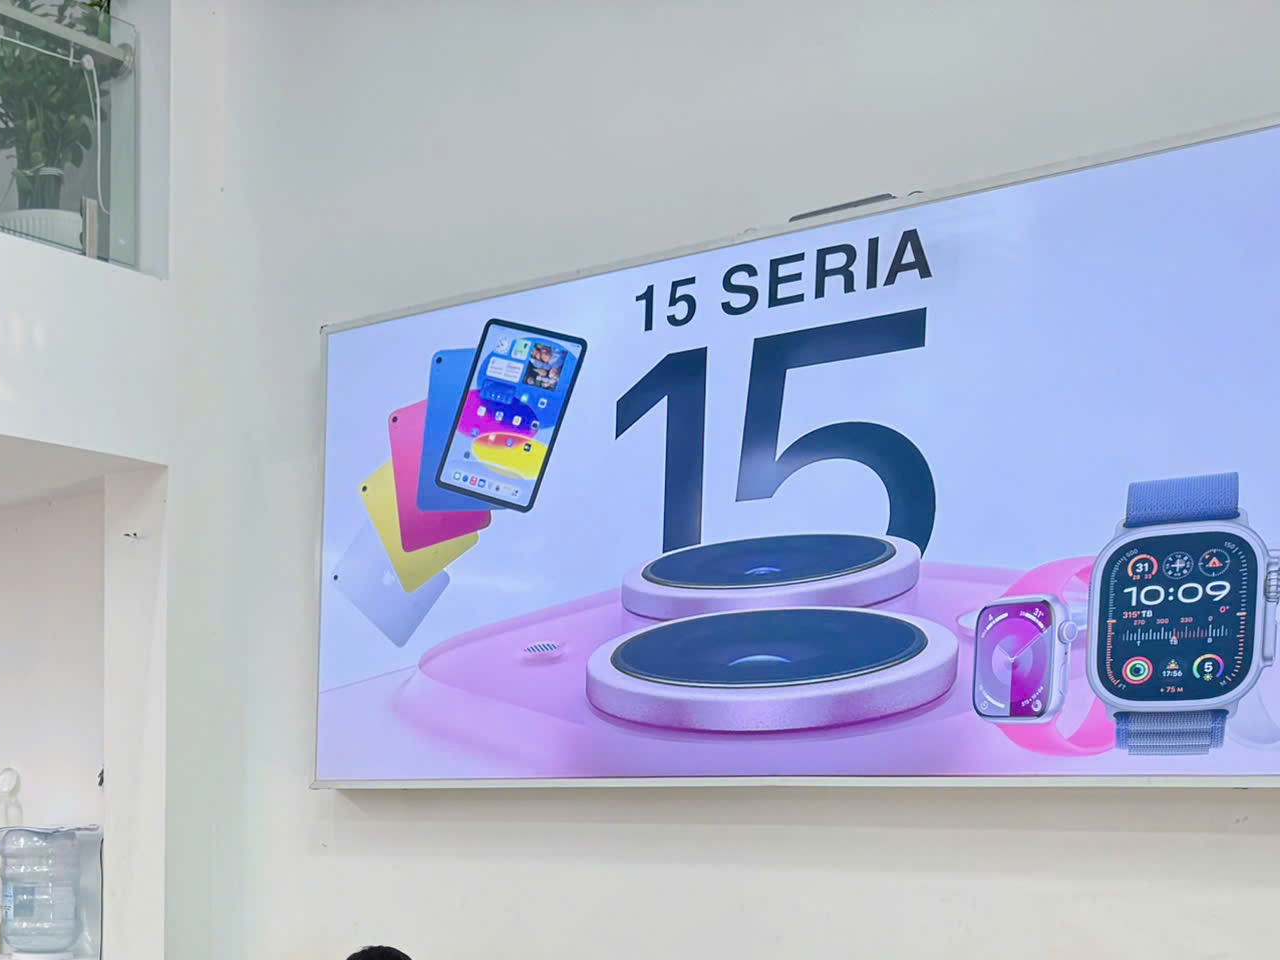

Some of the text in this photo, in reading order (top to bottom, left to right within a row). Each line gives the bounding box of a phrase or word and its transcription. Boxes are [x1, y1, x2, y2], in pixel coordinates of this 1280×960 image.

[635, 228, 933, 332] 15 SERIA
[614, 306, 937, 560] 15
[1135, 562, 1149, 573] 31
[1123, 580, 1232, 607] 10:09
[1203, 661, 1214, 673] 5
